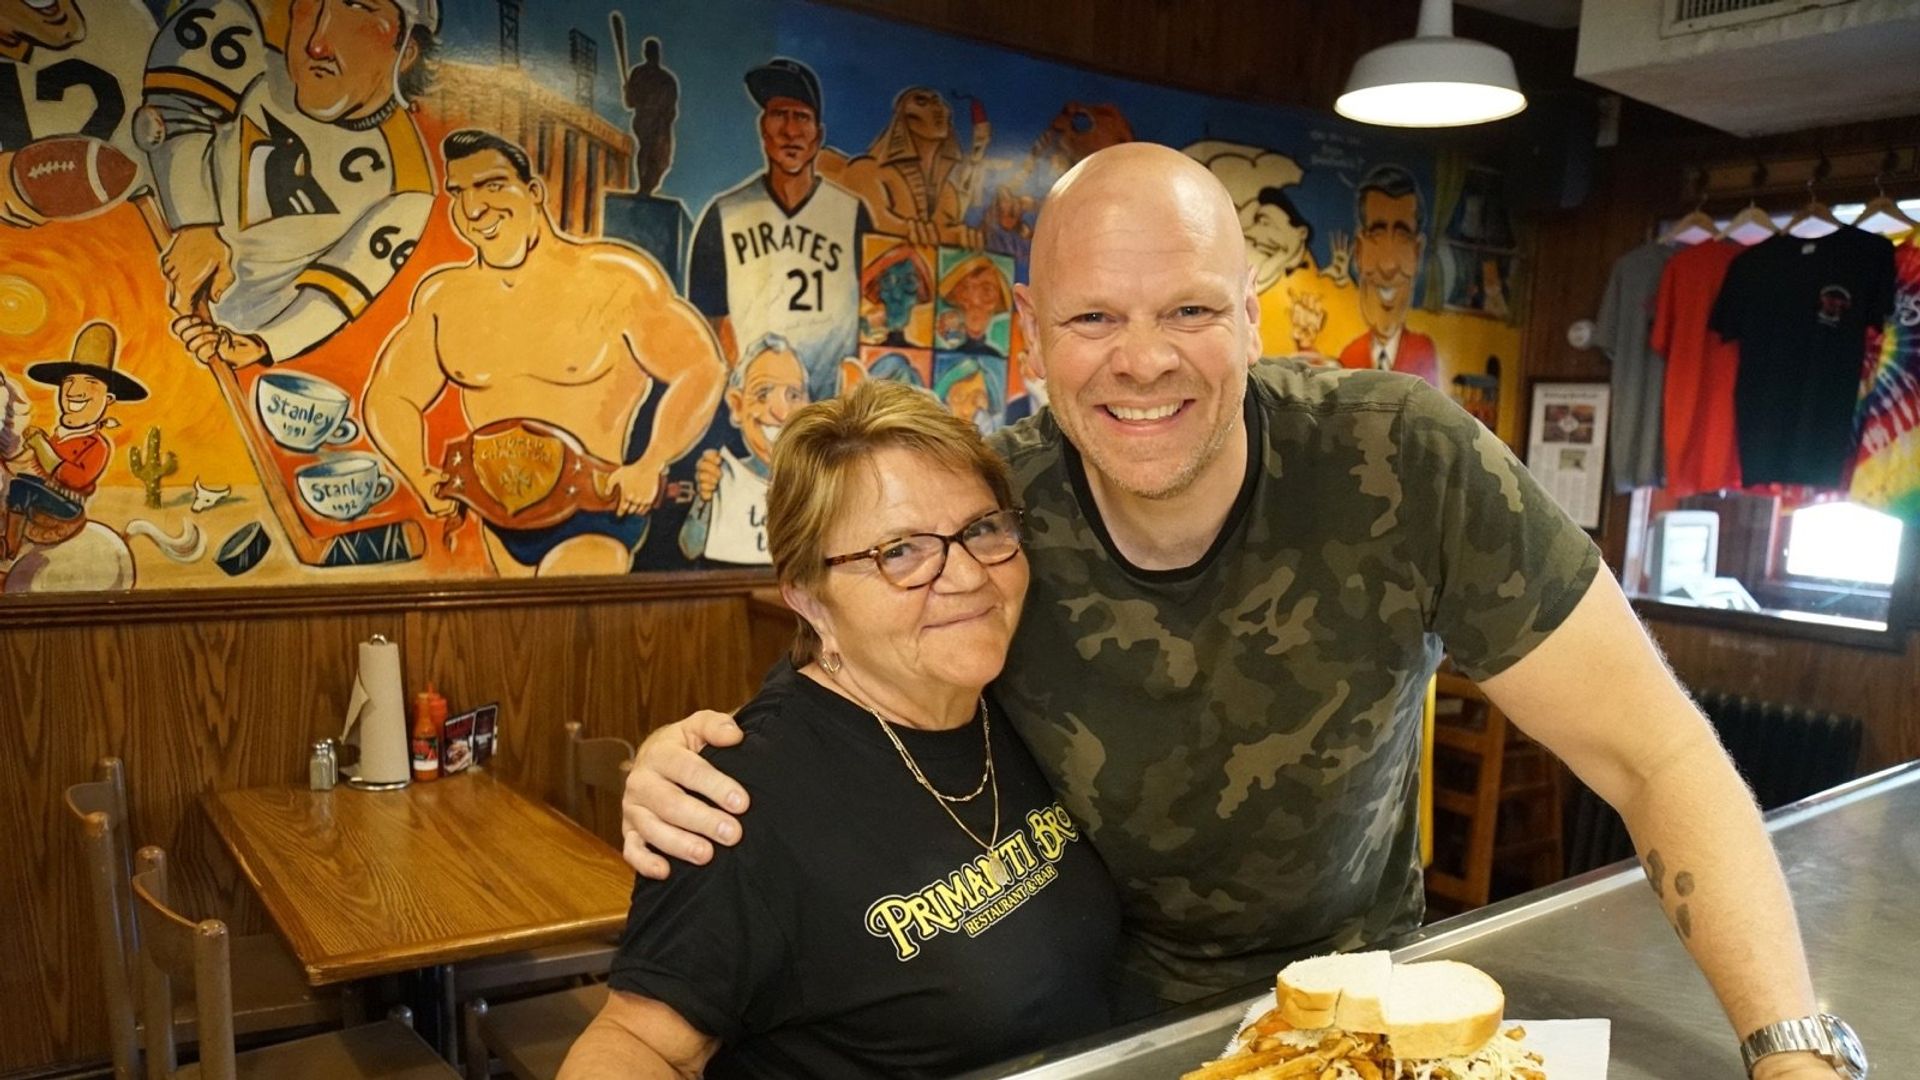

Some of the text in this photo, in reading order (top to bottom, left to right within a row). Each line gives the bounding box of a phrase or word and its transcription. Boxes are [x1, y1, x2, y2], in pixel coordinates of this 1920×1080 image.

[174, 8, 253, 69] 66
[340, 147, 385, 183] C
[731, 222, 843, 272] PIRATES
[787, 268, 823, 312] 21
[267, 395, 335, 431] Stanley
[311, 478, 374, 503] Stanley
[963, 864, 1056, 935] RESTAURANT & BAR
